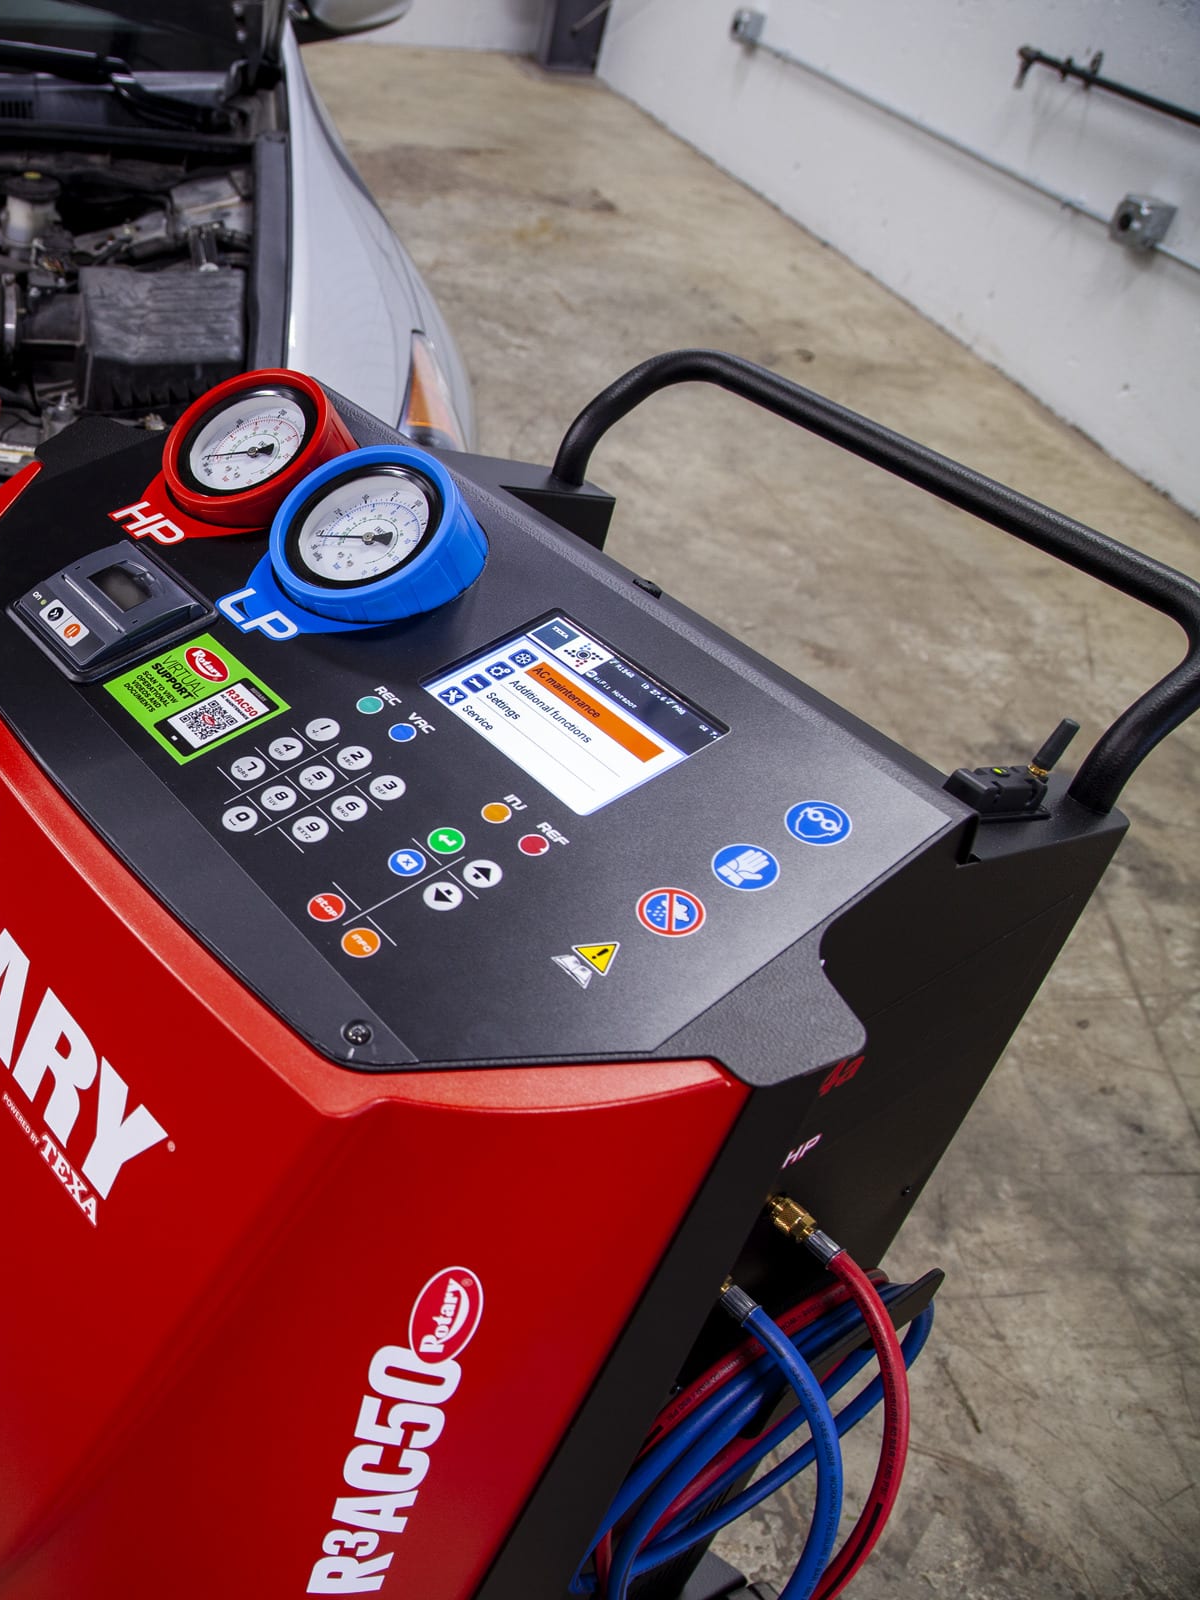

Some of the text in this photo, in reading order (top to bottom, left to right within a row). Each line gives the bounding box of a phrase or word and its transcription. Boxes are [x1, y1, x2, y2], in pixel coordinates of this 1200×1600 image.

[112, 501, 185, 543] HP
[218, 591, 298, 639] LP
[162, 655, 206, 698] VIRTUAL
[191, 649, 224, 678] Rotary
[132, 680, 161, 708] VIDEOS AND
[136, 674, 170, 707] OPERATIONAL
[143, 671, 178, 703] SCAN TO VIEW
[151, 662, 194, 699] SUPPORT
[532, 666, 601, 719] AC maintenance
[123, 682, 156, 712] DOCUMENTS
[226, 689, 259, 717] R3AC50
[374, 685, 402, 706] REC
[486, 692, 521, 721] Settings
[407, 712, 436, 734] VAC
[462, 704, 494, 731] Service
[508, 680, 592, 744] Additional functions
[283, 744, 296, 752] 4
[342, 755, 354, 766] ABC
[350, 751, 365, 761] 2
[234, 765, 249, 778] PQRS
[247, 761, 258, 771] 7
[312, 771, 327, 780] 5
[274, 791, 289, 801] 8
[375, 785, 387, 795] DEF
[382, 780, 398, 790] 3
[266, 796, 278, 806] TUV
[336, 805, 349, 817] MNO
[345, 801, 360, 811] 6
[503, 793, 528, 811] INJ
[305, 822, 321, 832] 9
[536, 821, 570, 846] REF
[3, 1093, 40, 1145] POWERED BY
[780, 1133, 823, 1170] HP
[40, 1134, 97, 1226] TEXA
[419, 1278, 470, 1353] Rotary
[871, 1323, 891, 1369] WORKING
[887, 1372, 898, 1423] PRESSURE
[790, 1367, 805, 1385] SAE
[817, 1421, 828, 1440] SAE
[306, 1345, 462, 1594] R3AC50
